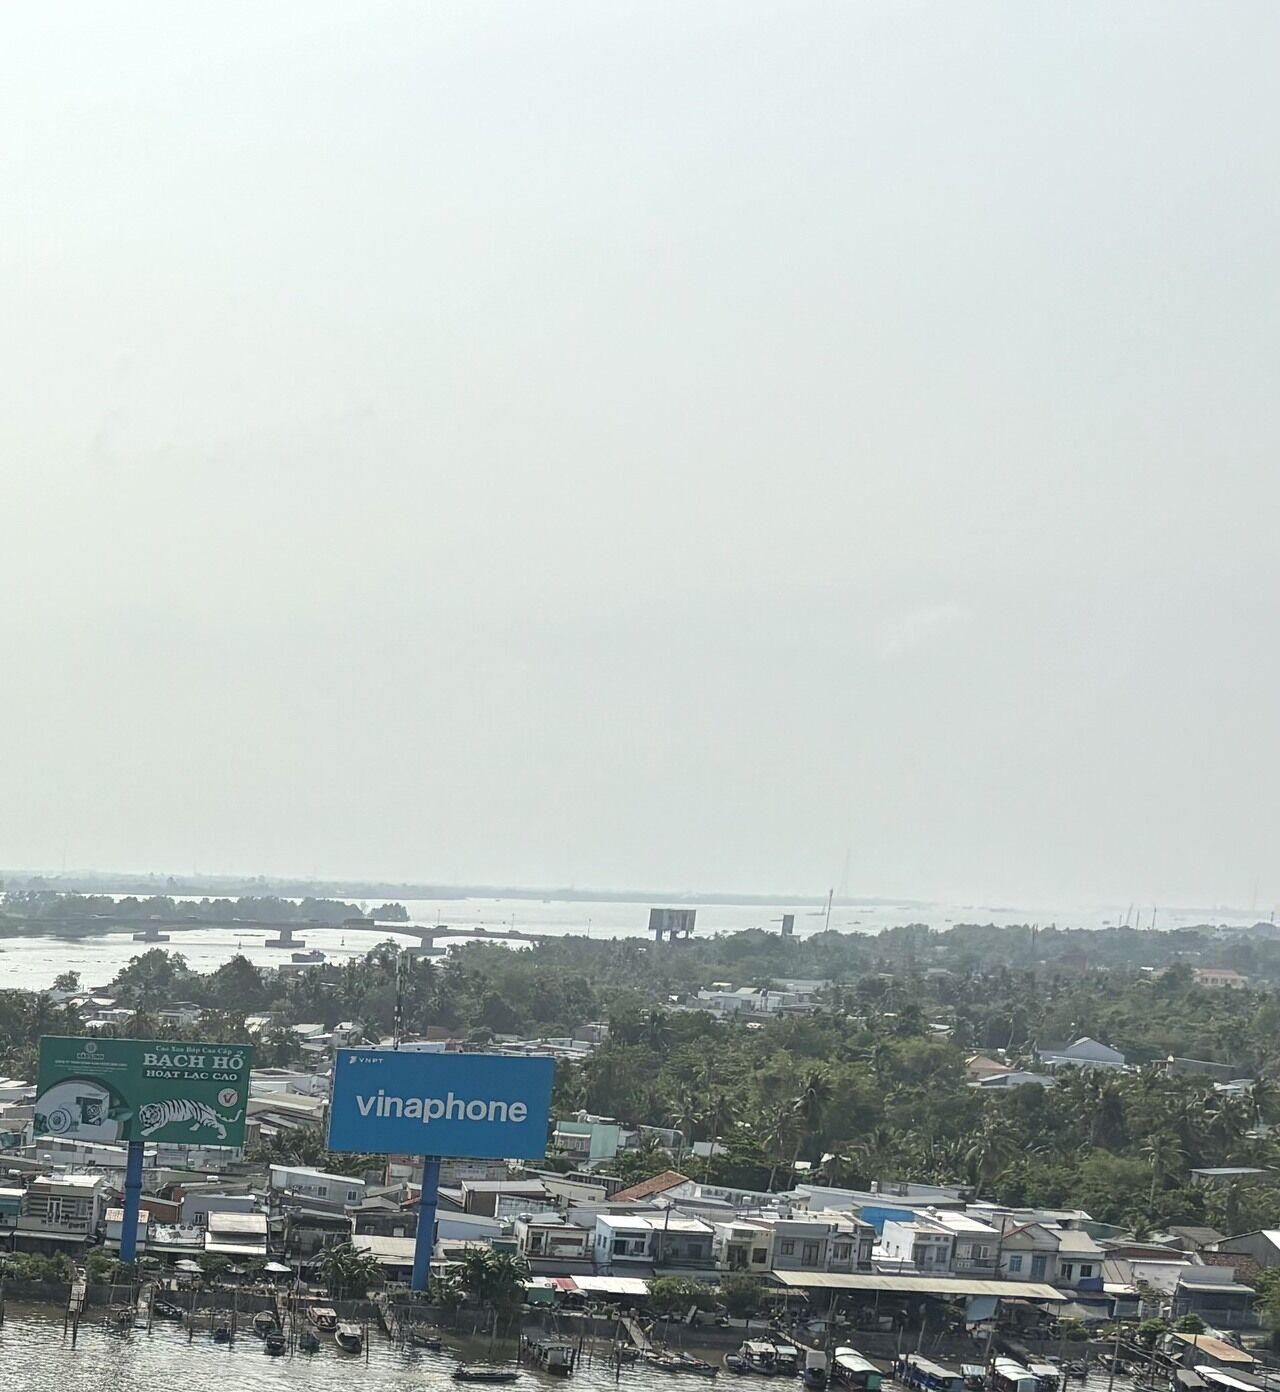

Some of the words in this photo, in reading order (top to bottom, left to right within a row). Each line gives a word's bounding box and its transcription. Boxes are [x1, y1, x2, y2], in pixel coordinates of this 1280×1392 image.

[143, 1053, 205, 1069] BẠCH
[146, 1070, 180, 1079] HOẠT
[184, 1071, 209, 1080] LẠC
[356, 1089, 528, 1123] vinaphone
